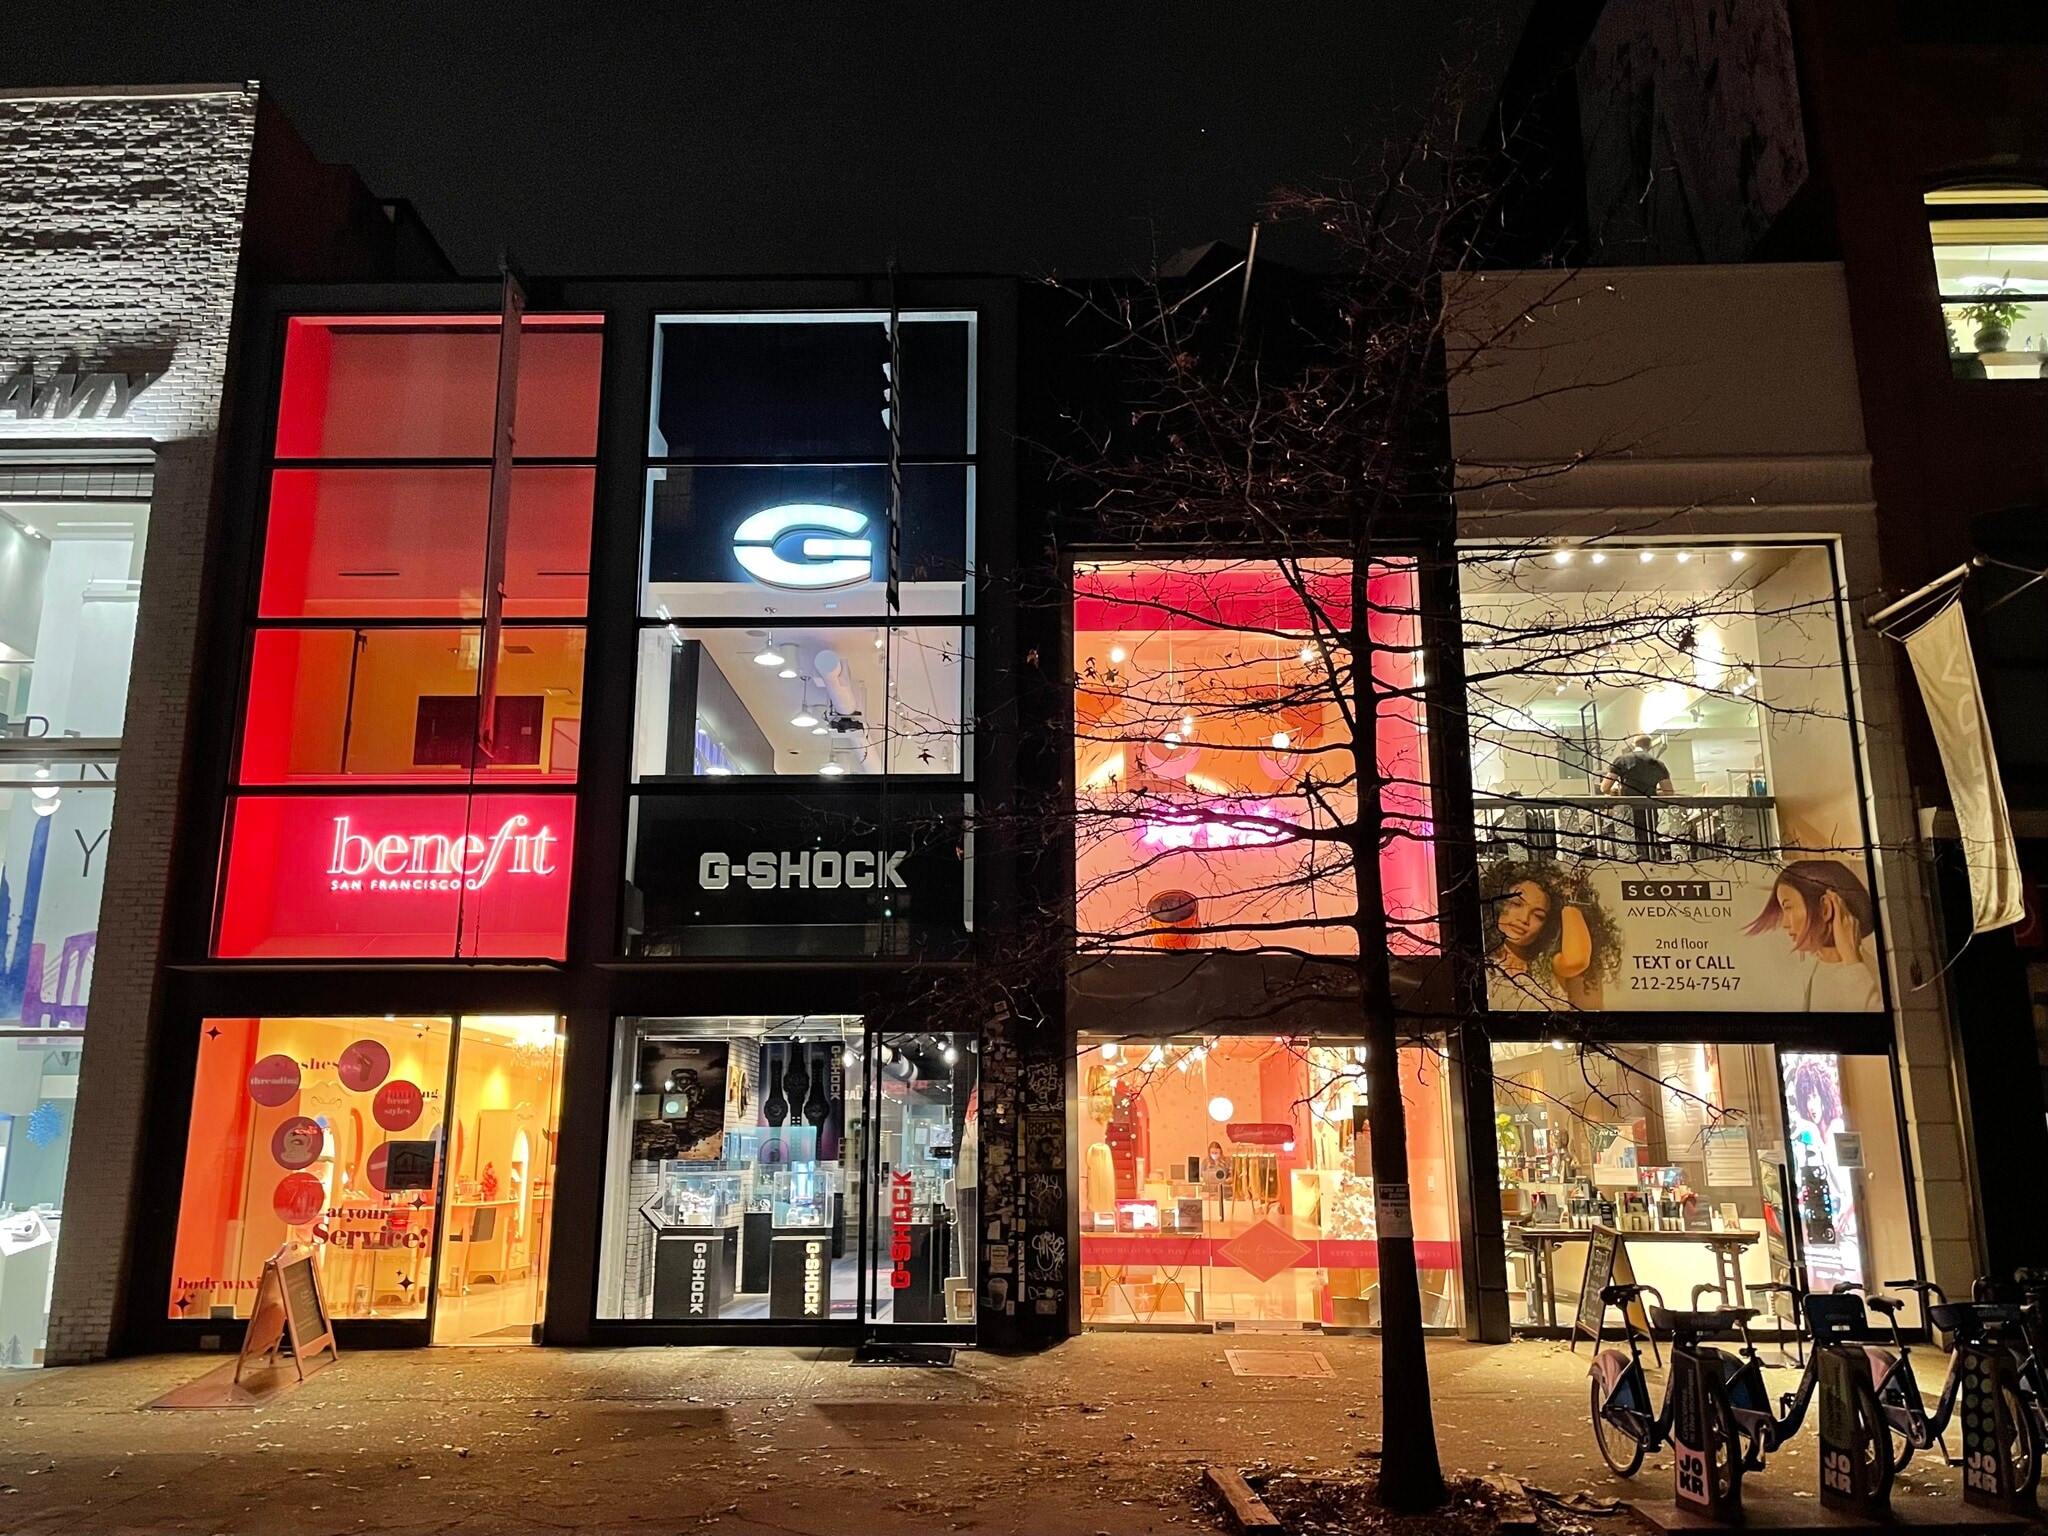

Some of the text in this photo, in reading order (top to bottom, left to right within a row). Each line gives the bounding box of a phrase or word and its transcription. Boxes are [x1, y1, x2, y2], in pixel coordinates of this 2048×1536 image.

[327, 814, 557, 889] benefit
[698, 850, 907, 889] G-SHOCK
[331, 879, 461, 891] SAN FRANCISCO
[1627, 884, 1703, 897] SCOTT
[1627, 906, 1732, 918] AVEDA SALON
[1655, 937, 1708, 950] 2nd floor
[1633, 955, 1735, 970] TEXT or CALL
[1631, 976, 1740, 991] 212-254-7547
[830, 1045, 841, 1100] G-SHOCK
[326, 1205, 389, 1223] at your
[311, 1222, 428, 1250] Service!
[889, 1170, 913, 1289] G-SHOCK
[177, 1276, 220, 1293] body
[689, 1242, 708, 1315] G-SHOCK
[803, 1242, 822, 1316] G-SHOCK
[1680, 1453, 1703, 1476] JO
[1824, 1451, 1851, 1474] JO
[1967, 1451, 1997, 1474] JO
[1680, 1471, 1704, 1496] KR
[1824, 1467, 1852, 1493] KR
[1967, 1467, 1998, 1494] KR
